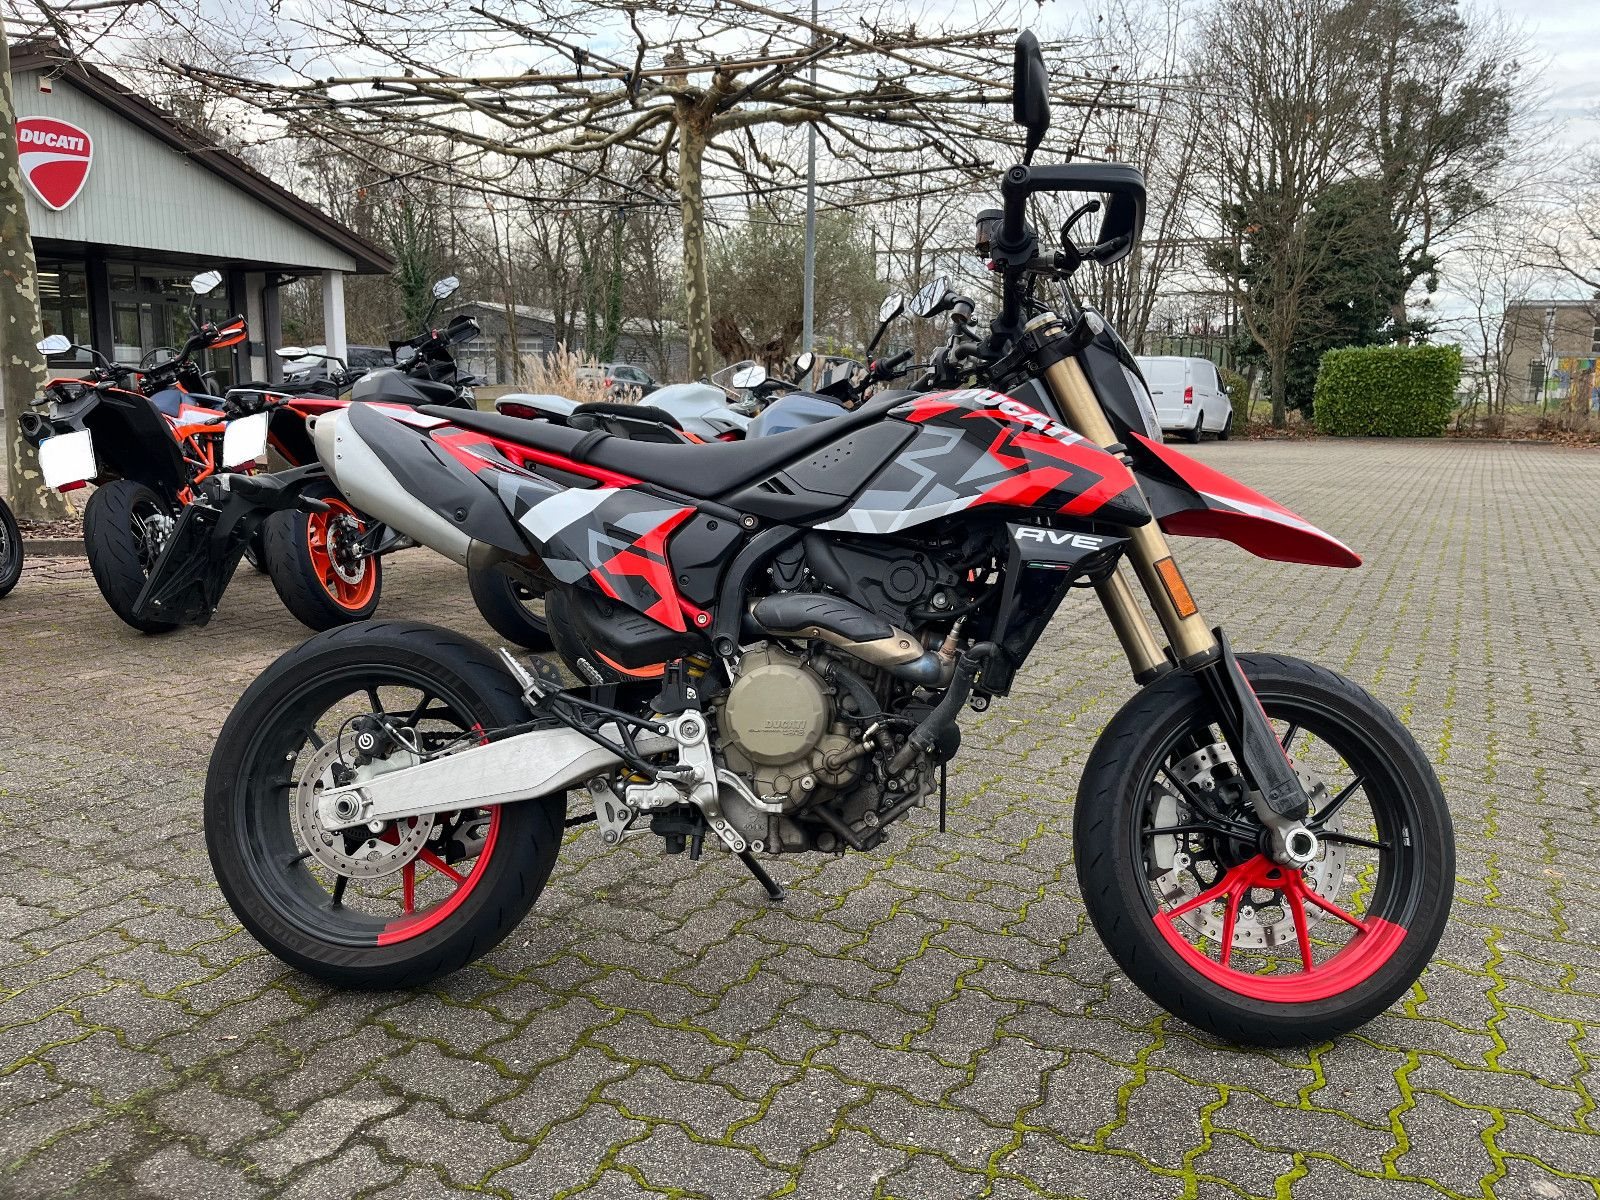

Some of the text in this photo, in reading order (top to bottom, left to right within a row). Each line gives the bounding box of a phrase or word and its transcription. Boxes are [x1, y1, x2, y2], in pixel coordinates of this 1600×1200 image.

[19, 128, 84, 151] DUCATI
[947, 388, 1084, 446] DUCATI
[764, 719, 807, 729] DUCATI
